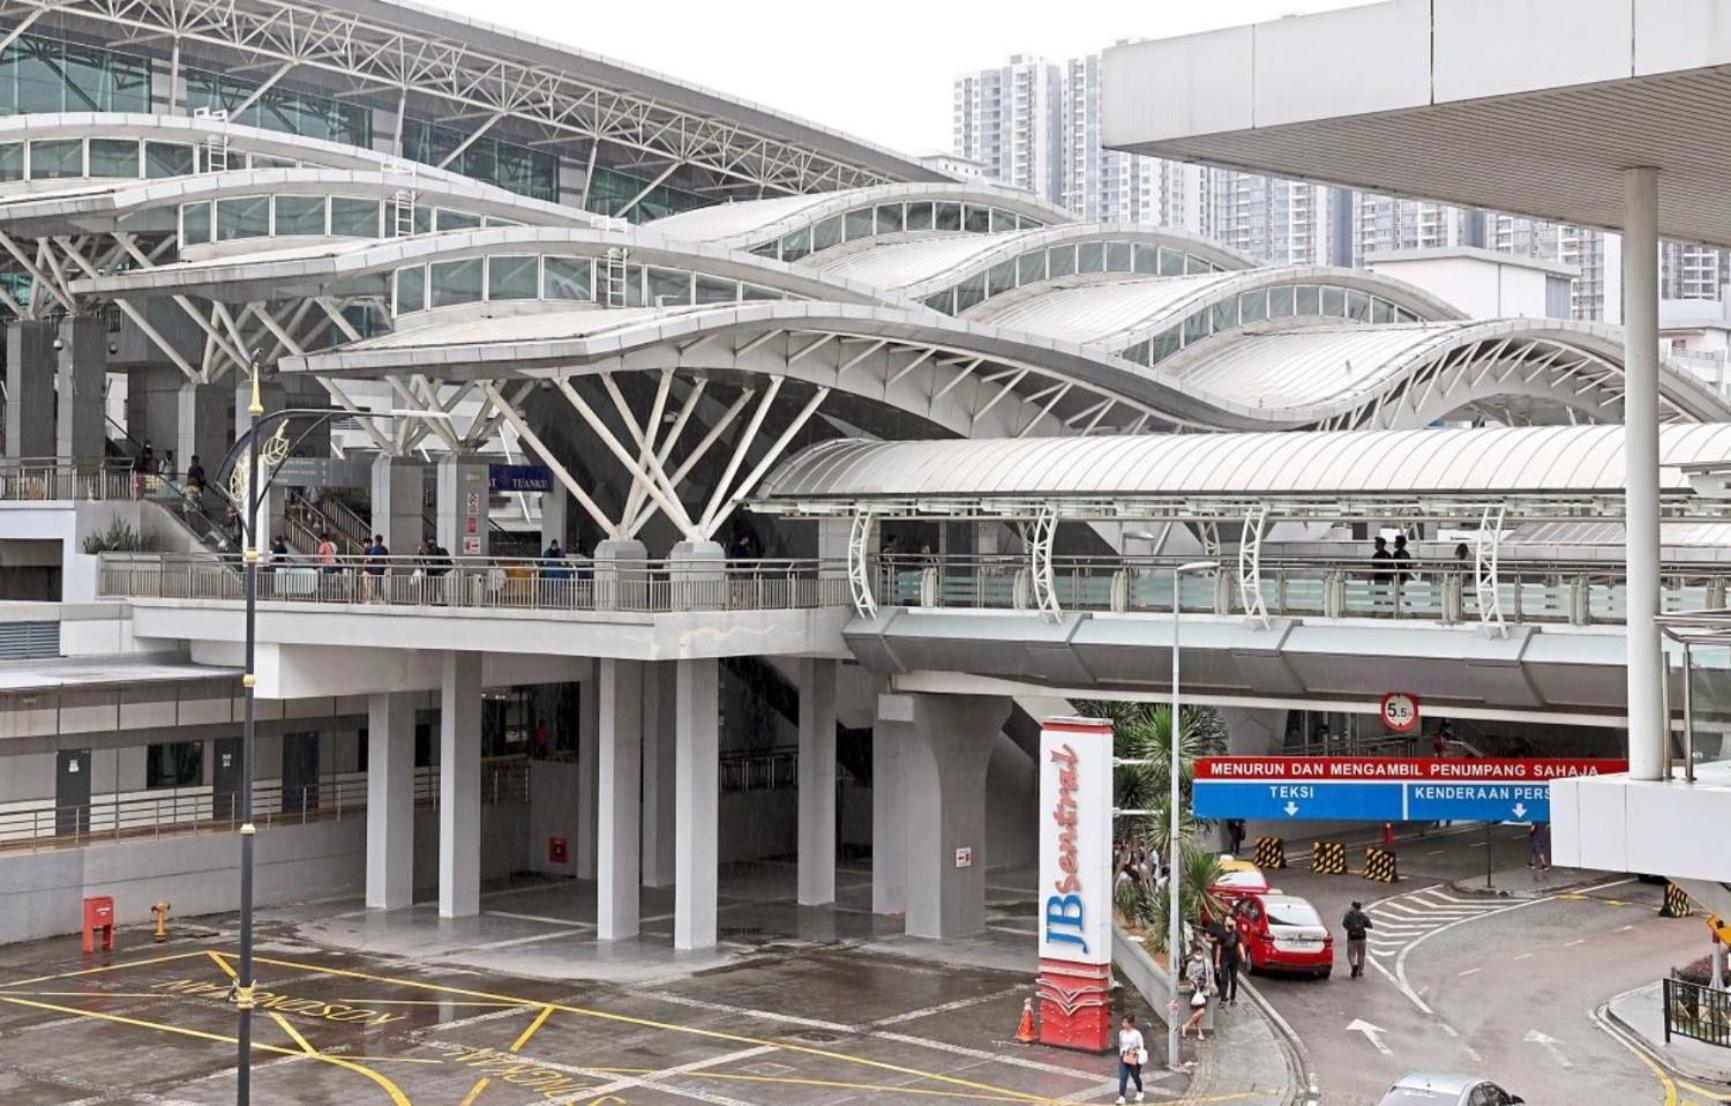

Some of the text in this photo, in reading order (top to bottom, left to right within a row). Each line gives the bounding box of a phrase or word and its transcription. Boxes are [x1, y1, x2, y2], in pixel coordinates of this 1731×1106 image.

[1211, 763, 1598, 777] MENURUN DAN MENGAMBIL PENUMPANG SAHAJA
[1269, 786, 1314, 798] TEKSI
[1414, 787, 1510, 799] KENDERAAN
